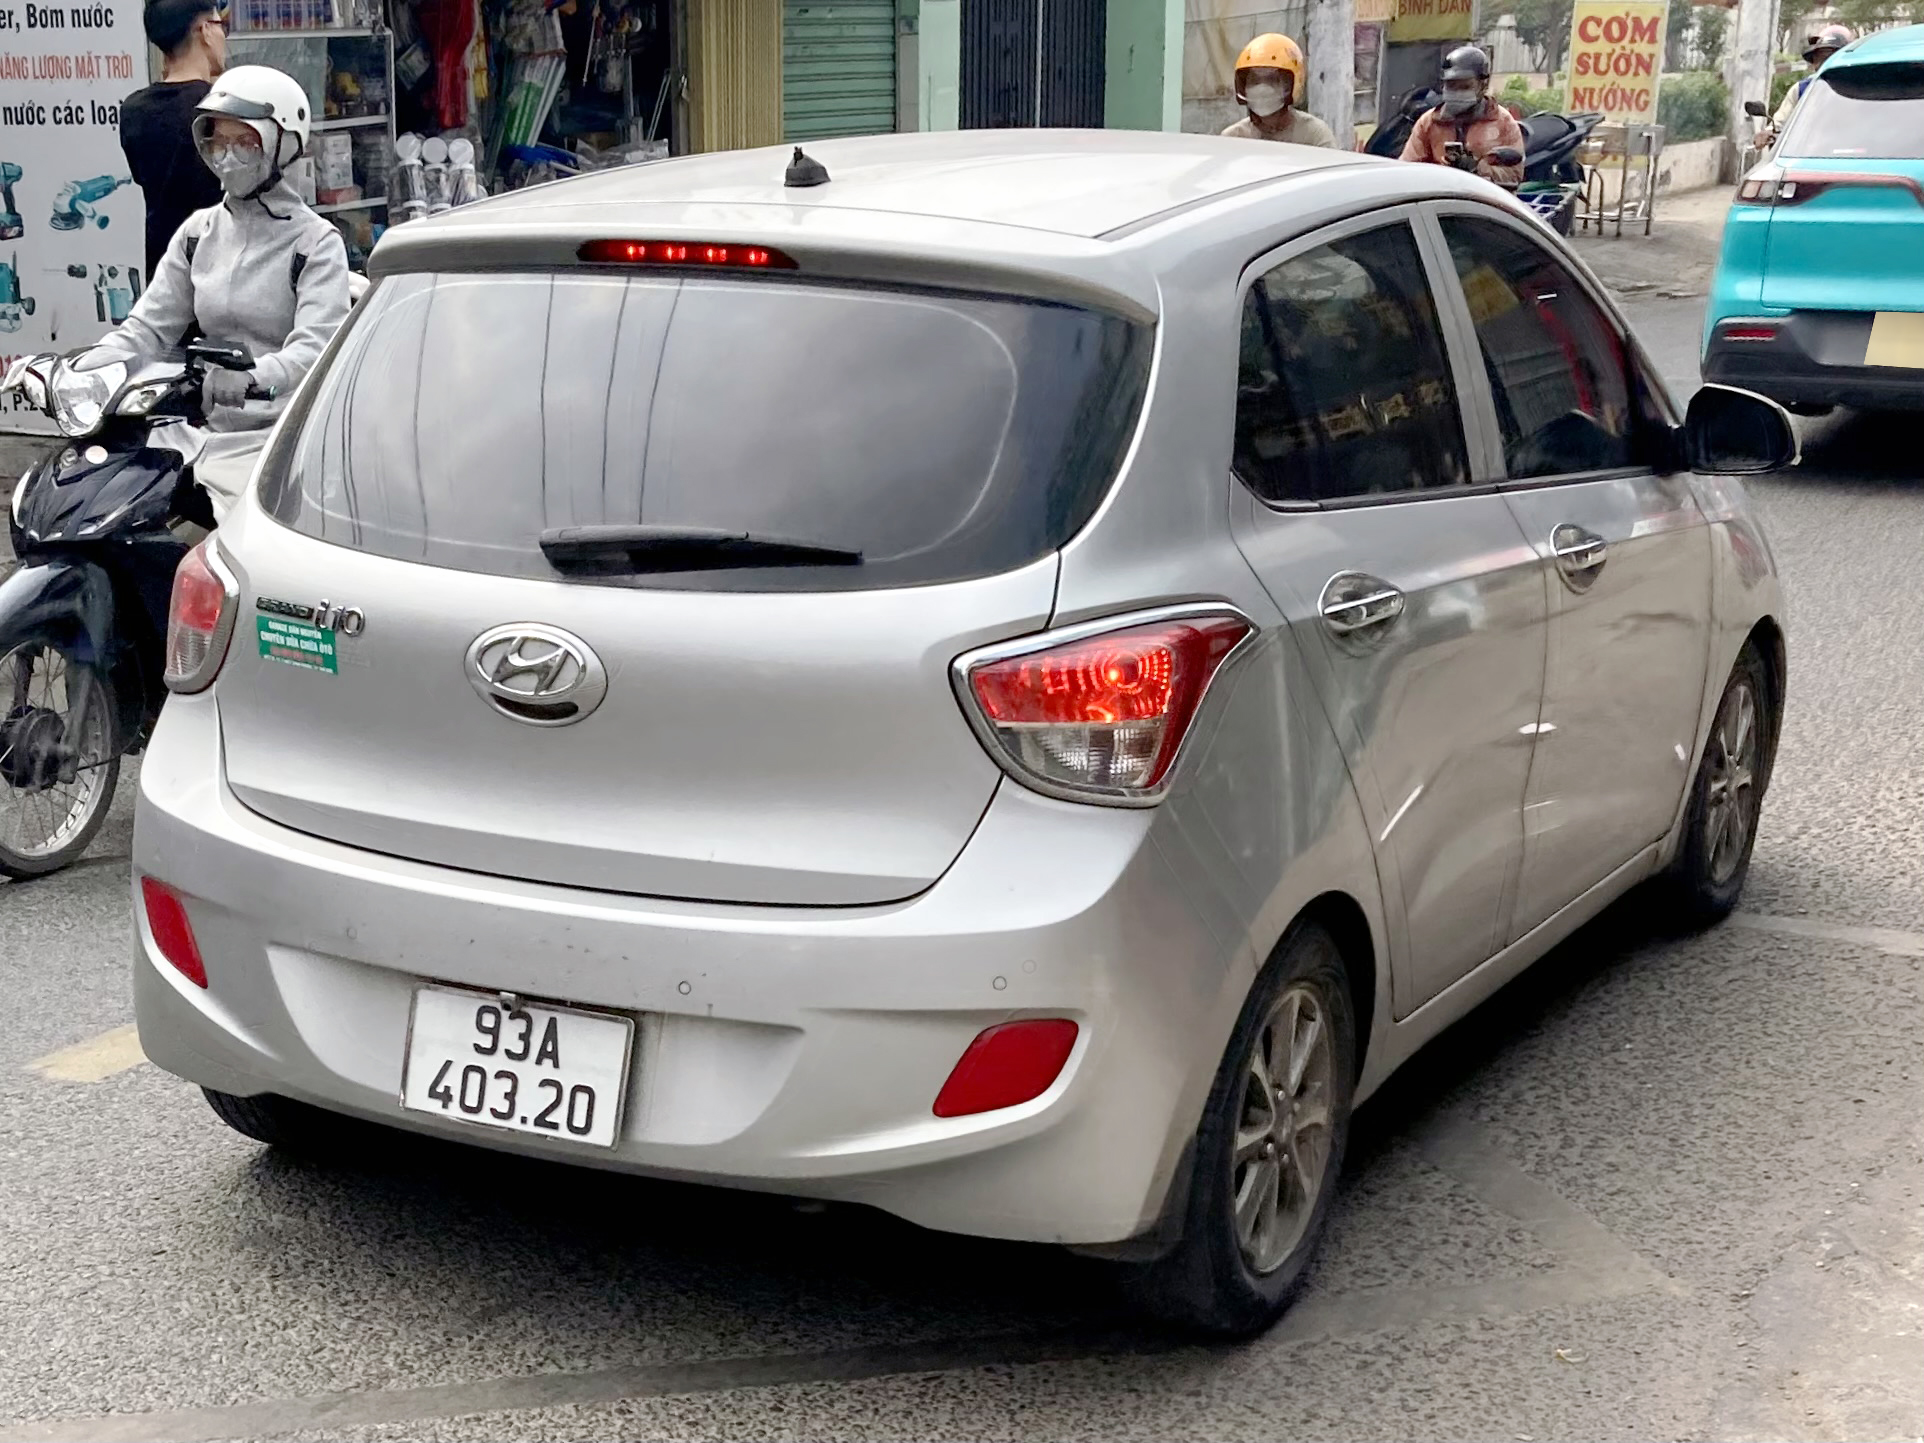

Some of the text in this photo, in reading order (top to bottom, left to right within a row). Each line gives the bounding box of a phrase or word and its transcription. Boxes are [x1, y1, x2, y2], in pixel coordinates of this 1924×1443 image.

[26, 3, 65, 29] Bơm
[71, 1, 114, 29] nước
[1578, 11, 1661, 45] CƠM
[32, 53, 72, 85] LƯỢNG
[75, 50, 102, 84] MẶT
[105, 50, 133, 79] TRỜI
[1575, 45, 1655, 77] SƯỜN
[3, 99, 46, 126] nước
[53, 99, 85, 126] các
[1570, 81, 1650, 112] NƯỚNG
[473, 1005, 560, 1069] 93A
[428, 1060, 596, 1136] 403.20
